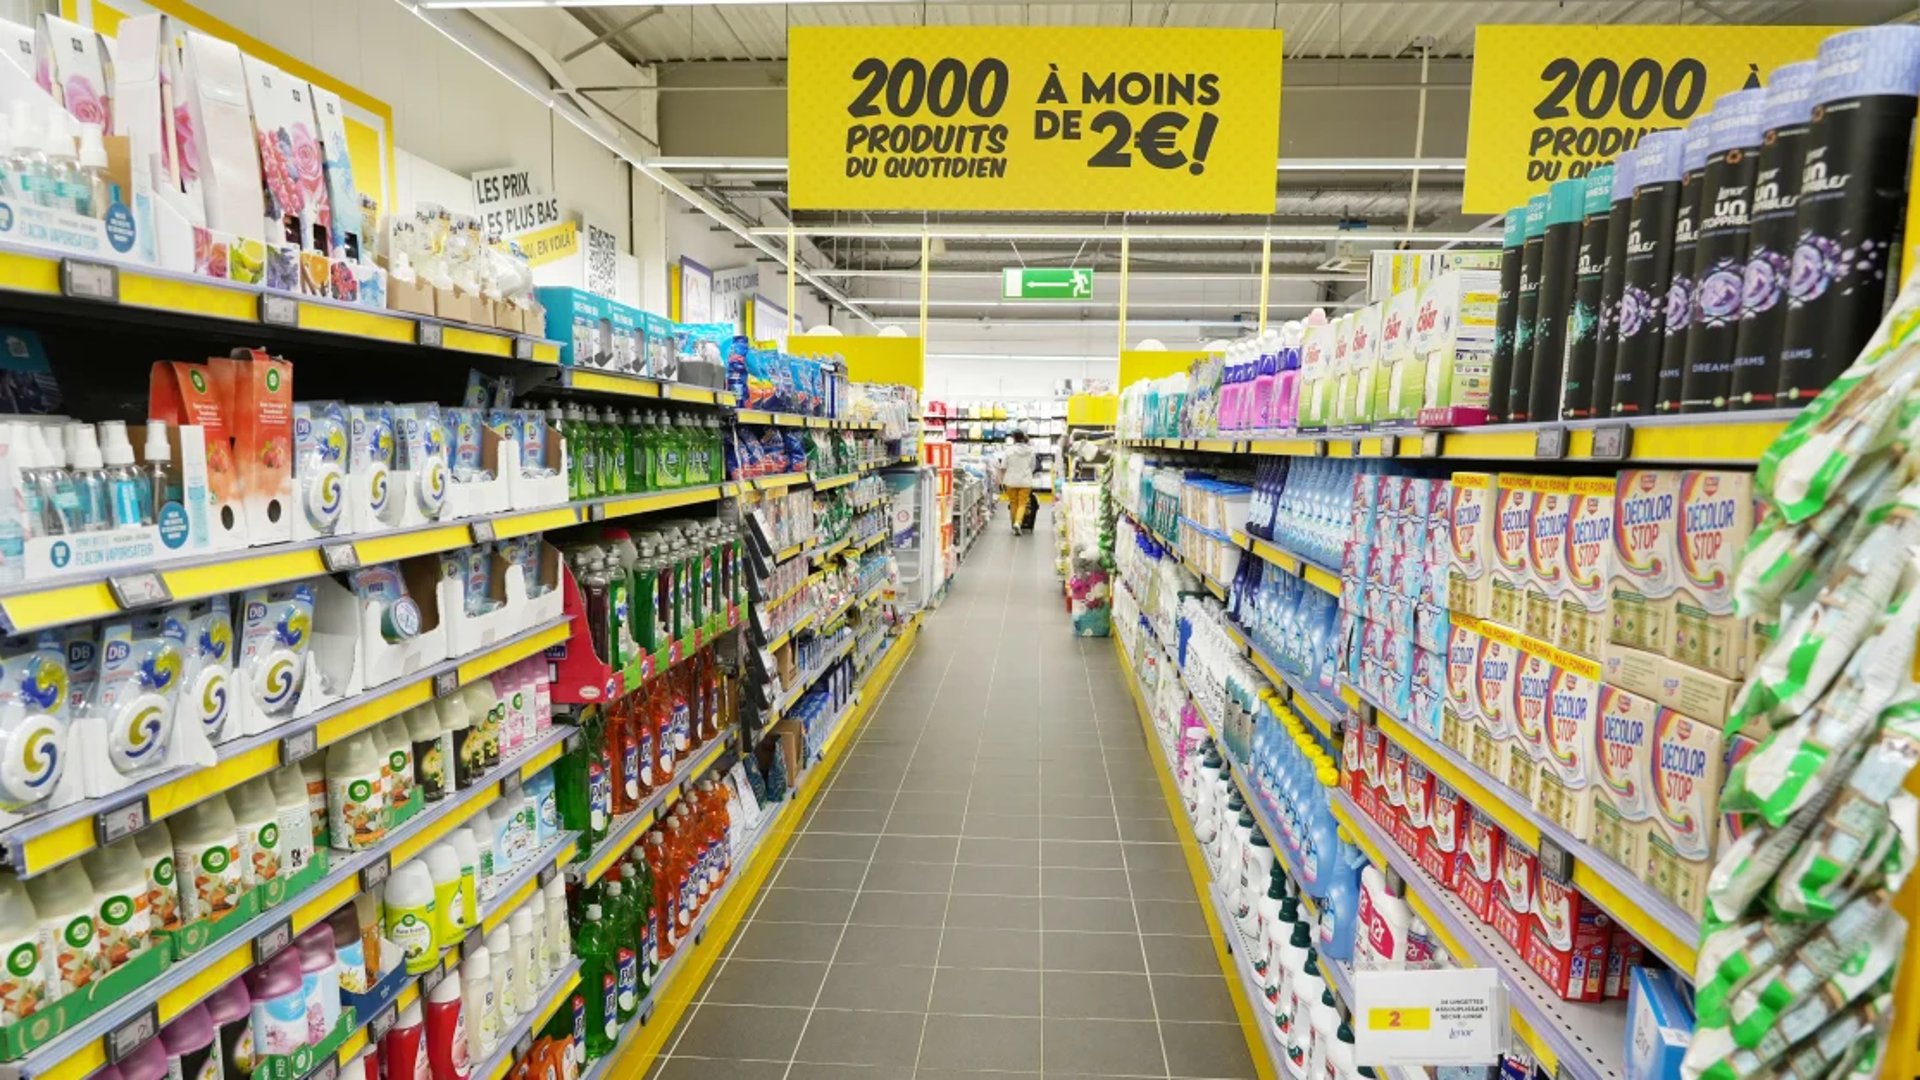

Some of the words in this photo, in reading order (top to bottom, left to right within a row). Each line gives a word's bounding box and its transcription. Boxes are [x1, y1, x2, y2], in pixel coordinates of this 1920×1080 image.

[847, 58, 1009, 118] 2000
[1036, 63, 1068, 104] À
[1082, 71, 1220, 106] MOINS
[1533, 58, 1707, 120] 2000
[846, 123, 1008, 154] PRODUITS
[1034, 110, 1082, 140] DE
[1529, 126, 1683, 156] PRODU
[846, 157, 876, 178] DU
[884, 156, 1006, 178] QUOTIDIEN
[1527, 160, 1562, 181] DU
[477, 176, 500, 204] LES
[503, 171, 531, 199] PRIX
[506, 204, 535, 232] PLUS
[537, 199, 559, 224] BAS
[1624, 493, 1673, 526] DÉCOLOR
[1686, 498, 1735, 533] DÉCOLOR
[1630, 524, 1660, 551] STOP
[1693, 532, 1723, 561] STOP
[1577, 543, 1600, 567] STOP
[107, 643, 127, 660] DB
[1556, 719, 1578, 742] STOP
[1603, 711, 1643, 747] DÉCOLOR
[1607, 743, 1633, 771] STOP
[1660, 737, 1706, 778] DÉCOLOR
[1666, 773, 1693, 804] STOP
[1389, 1011, 1401, 1027] 2
